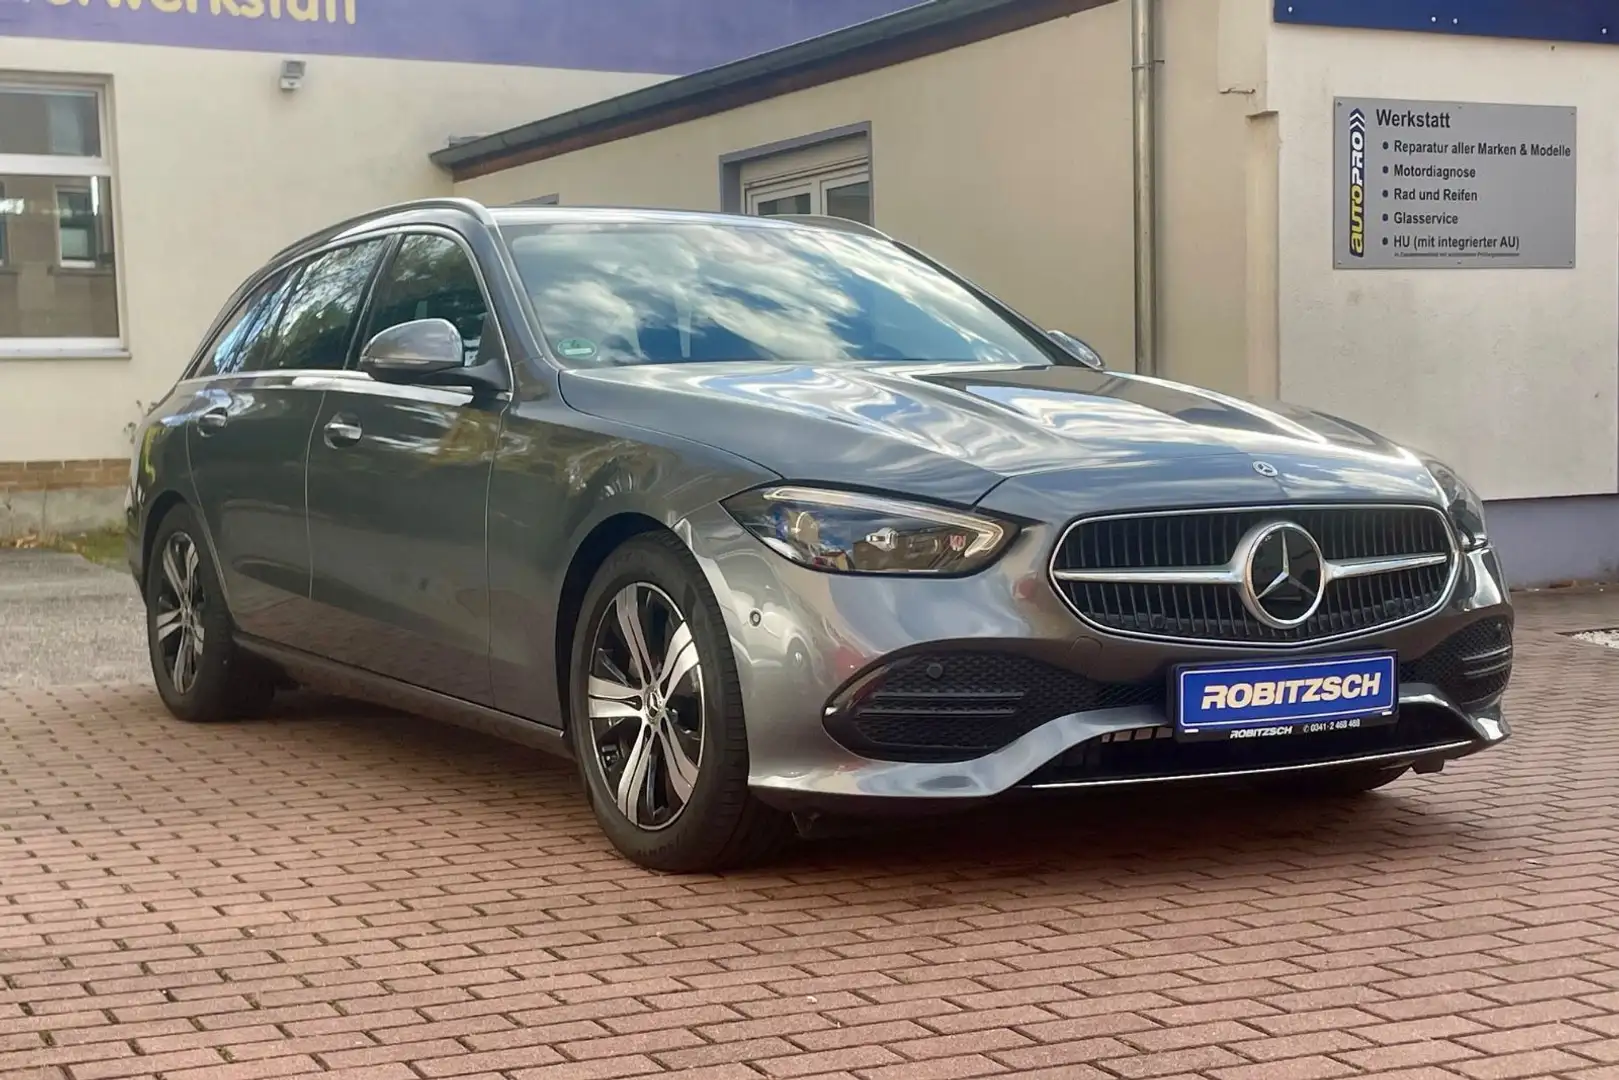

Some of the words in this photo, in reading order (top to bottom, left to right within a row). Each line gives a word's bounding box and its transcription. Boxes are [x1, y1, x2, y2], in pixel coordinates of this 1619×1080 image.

[1376, 108, 1451, 128] Werkstatt
[1394, 140, 1449, 156] Reparatur
[1451, 142, 1475, 154] aller
[1478, 142, 1517, 155] Marken
[1519, 144, 1528, 156] &
[1530, 144, 1571, 157] Modelle
[1394, 164, 1476, 180] Motordiagnose
[1394, 188, 1416, 200] Rad
[1419, 189, 1440, 200] und
[1443, 189, 1478, 201] Reifen
[1394, 211, 1459, 224] Glasservice
[1394, 235, 1410, 247] HU
[1413, 235, 1435, 250] (mit
[1438, 236, 1498, 250] integrierter
[1500, 236, 1520, 250] AU)
[1201, 672, 1382, 710] ROBITZSCH
[1230, 725, 1293, 739] ROBITZSCH
